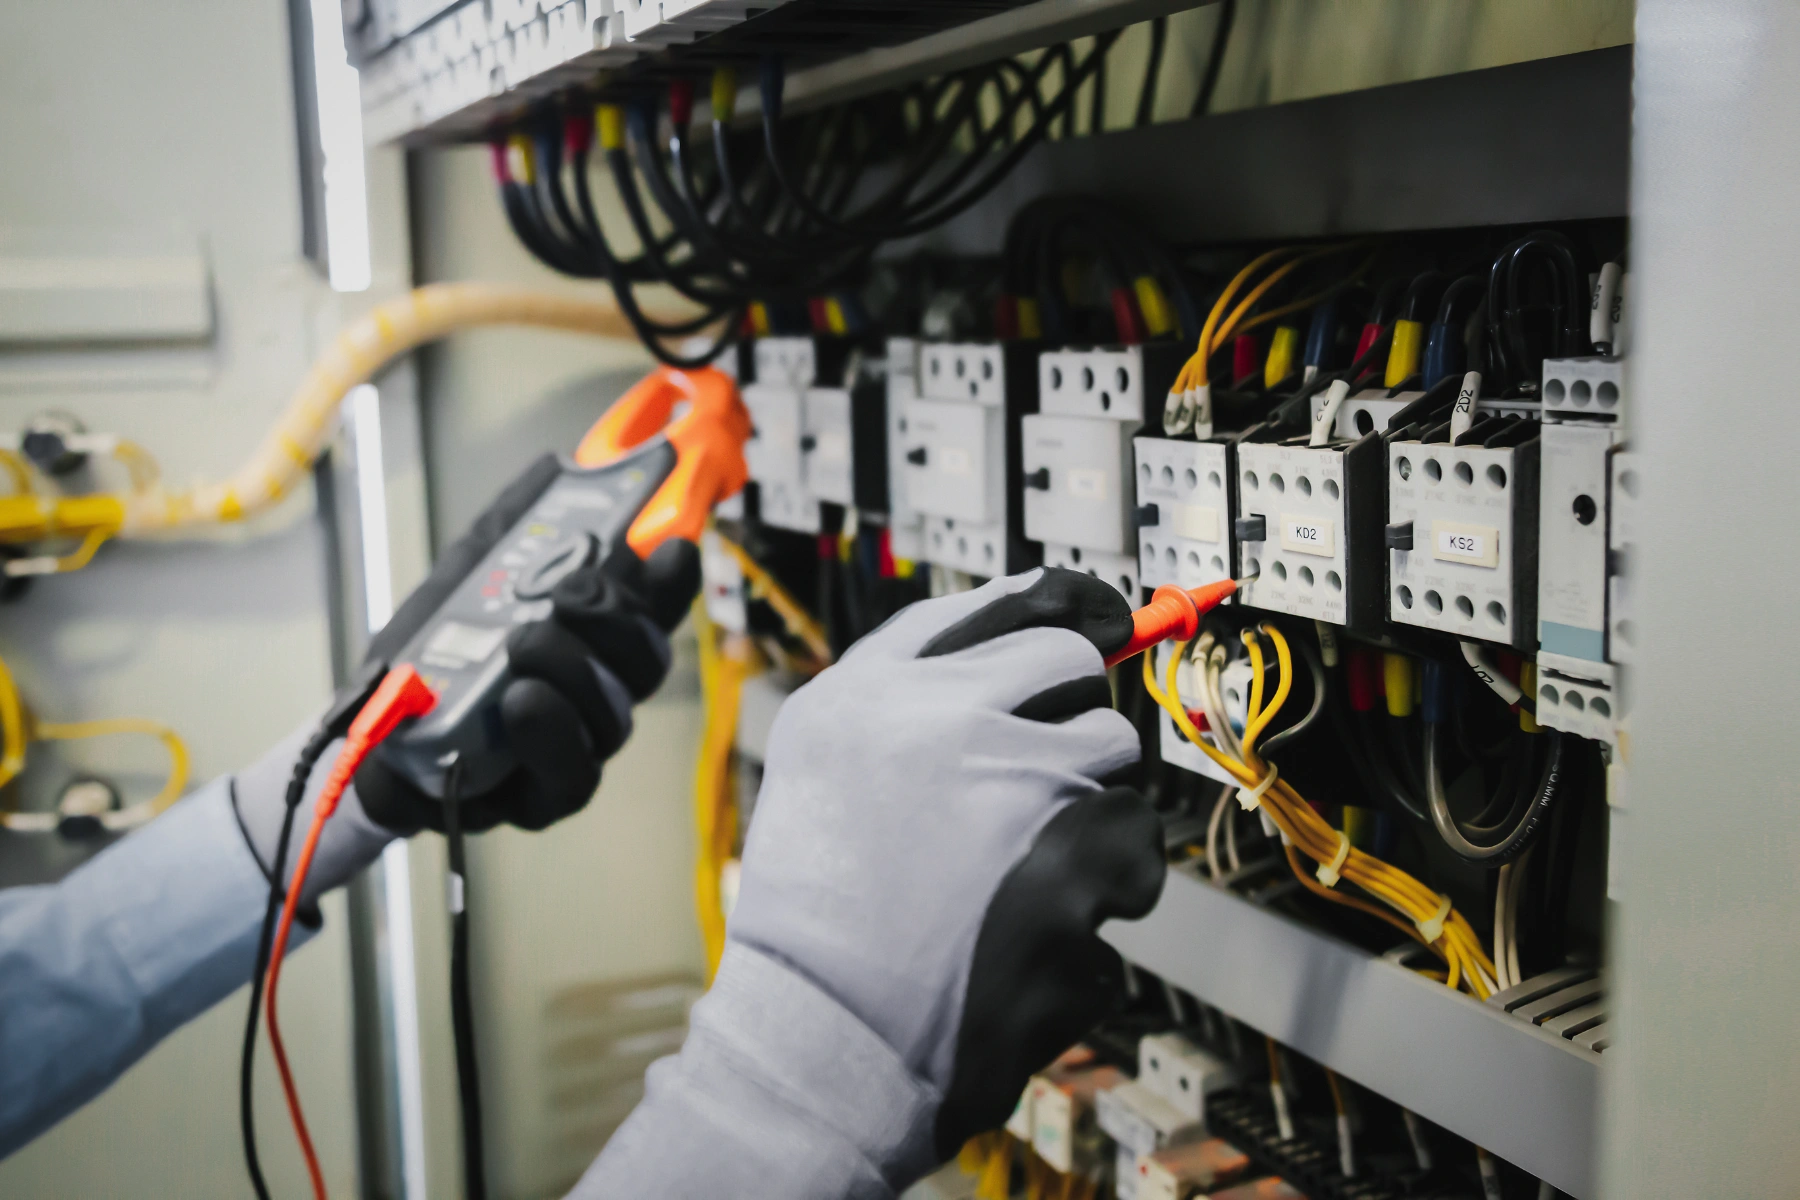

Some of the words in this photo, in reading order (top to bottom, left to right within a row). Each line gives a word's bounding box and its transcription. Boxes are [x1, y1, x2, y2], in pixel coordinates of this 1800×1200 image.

[1456, 389, 1473, 412] 2D2
[1296, 526, 1317, 540] KD2
[1449, 536, 1474, 551] KS2
